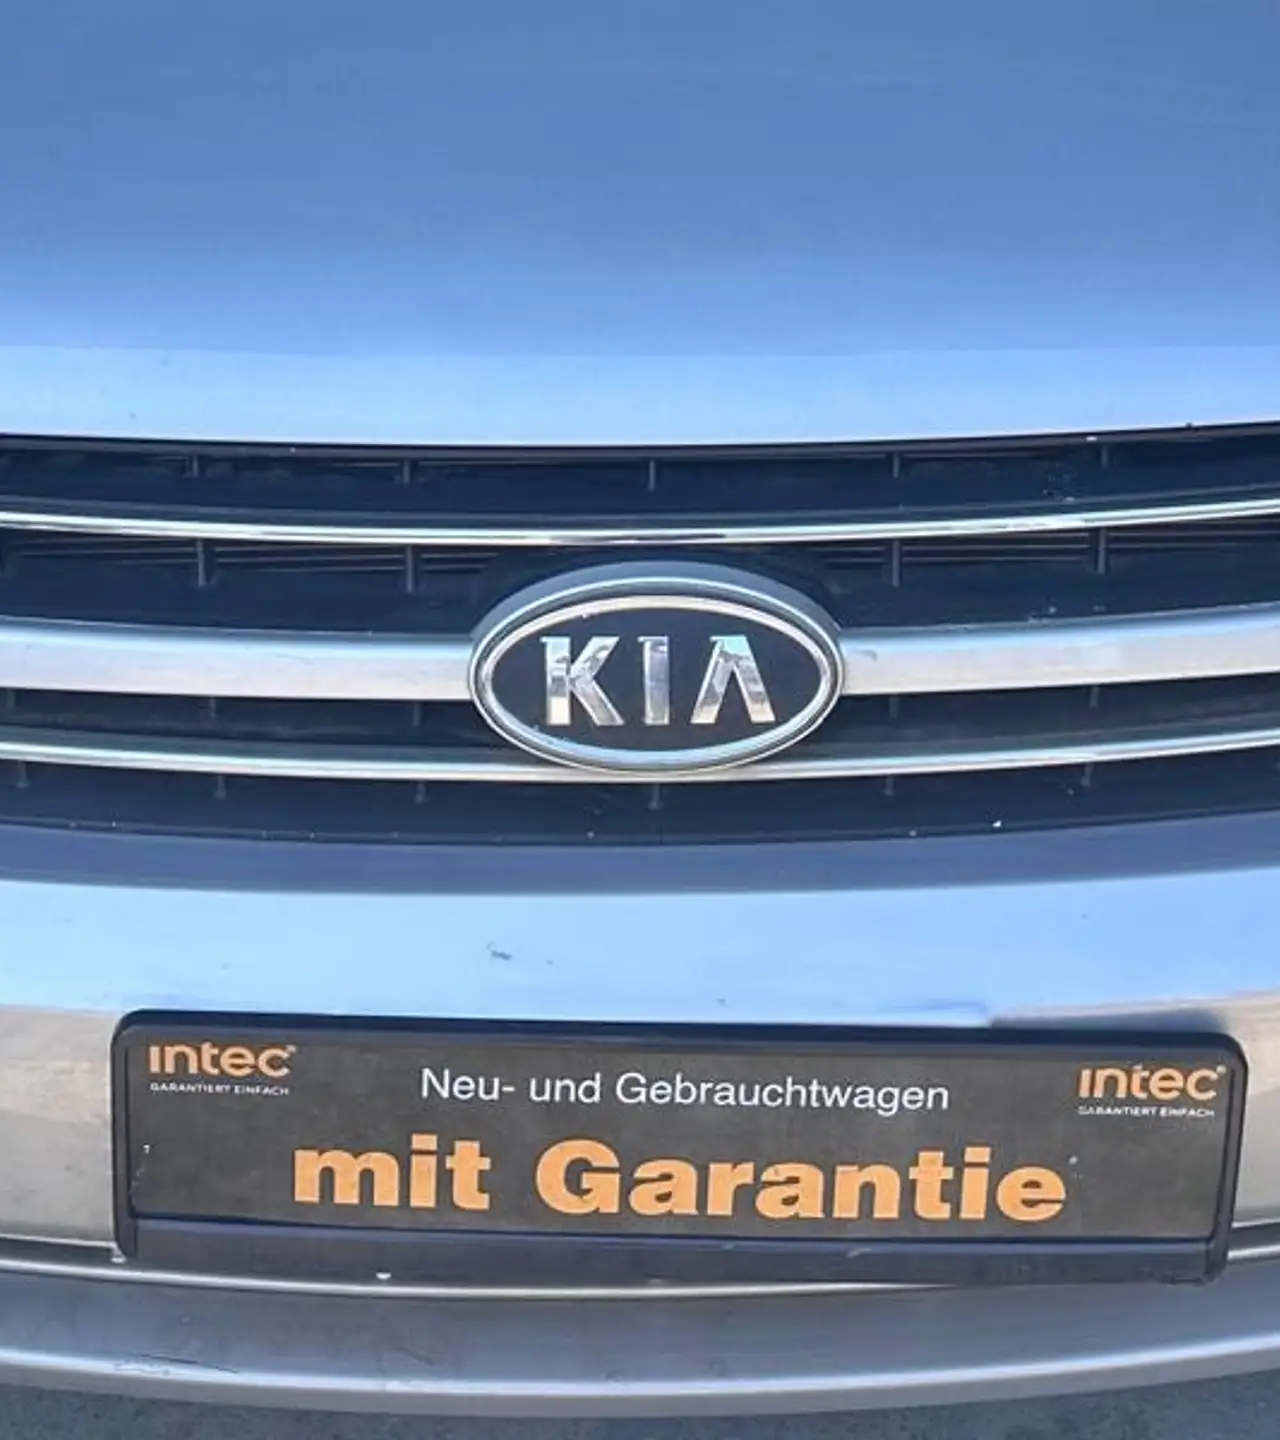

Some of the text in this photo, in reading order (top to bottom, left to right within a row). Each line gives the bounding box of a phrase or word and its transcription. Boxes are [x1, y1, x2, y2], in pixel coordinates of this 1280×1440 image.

[539, 635, 776, 726] KIA
[148, 1041, 293, 1077] intec
[150, 1081, 289, 1096] GARANTIERT EINFACH
[420, 1067, 951, 1118] Neu- und Gebrauchtwagen
[1078, 1063, 1220, 1101] intec
[293, 1133, 1068, 1223] mit Garantie
